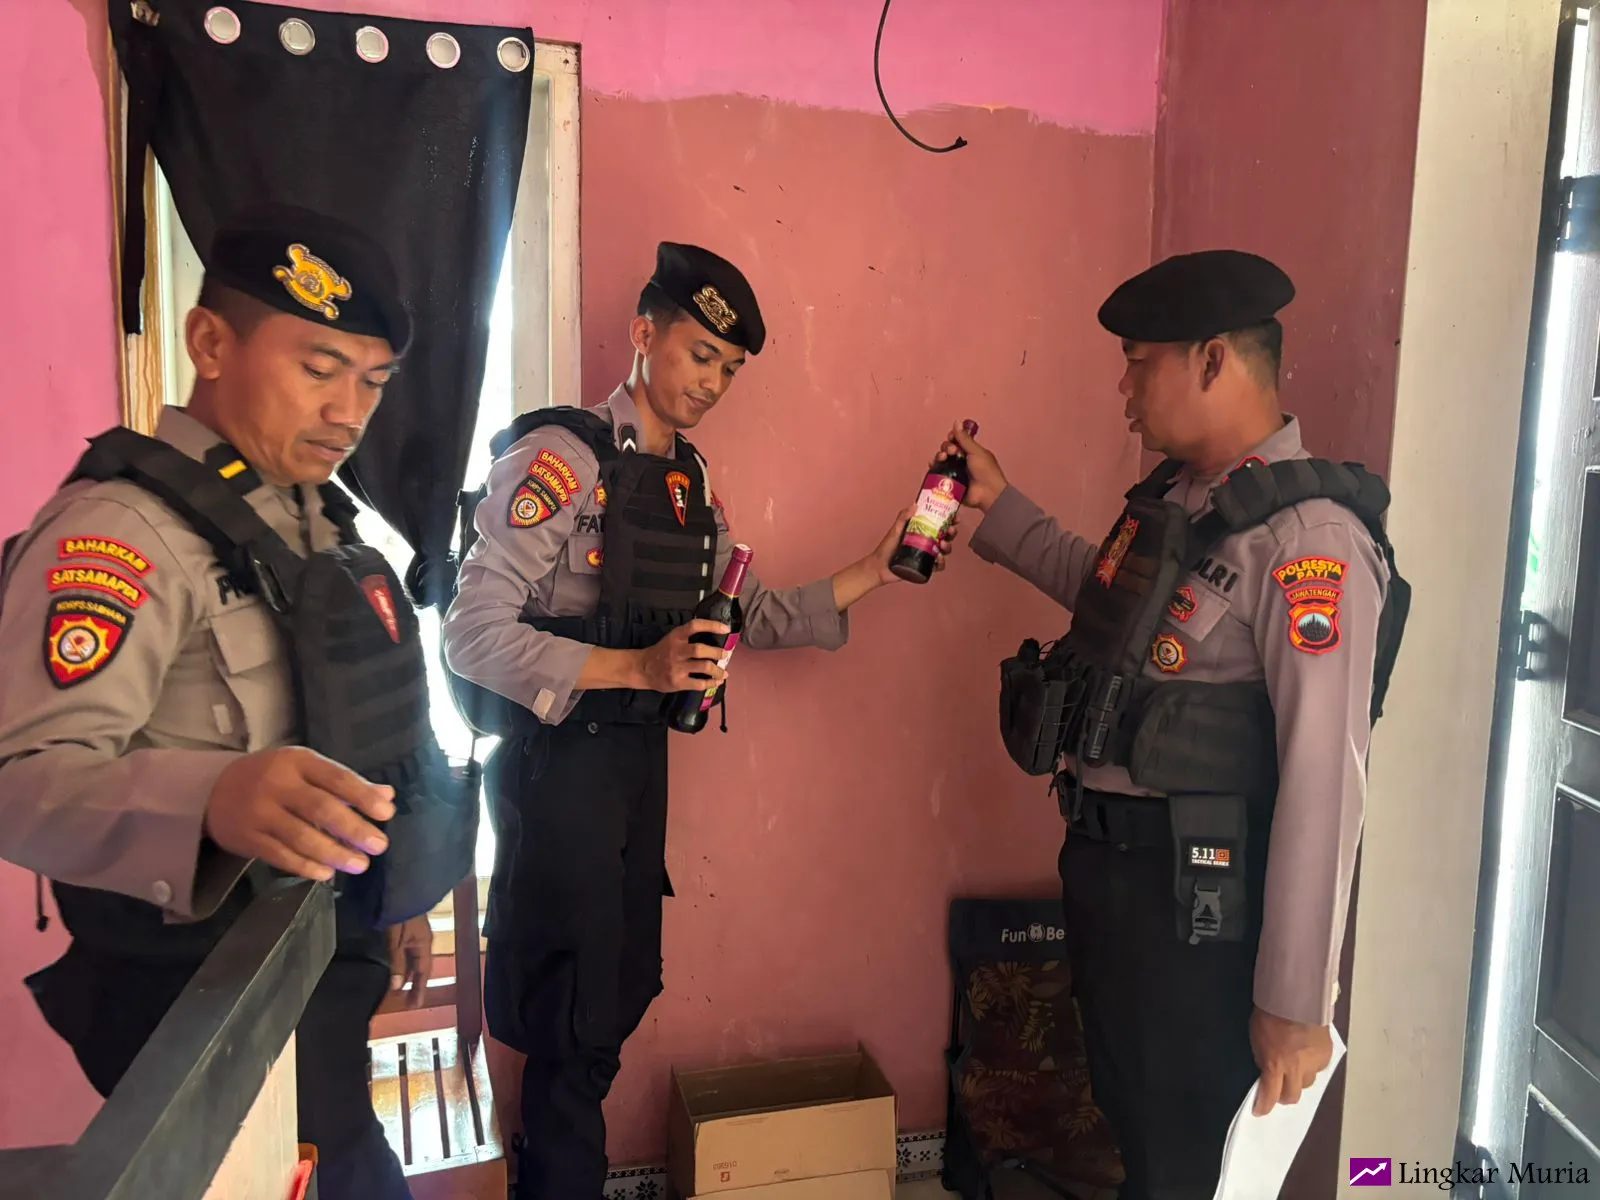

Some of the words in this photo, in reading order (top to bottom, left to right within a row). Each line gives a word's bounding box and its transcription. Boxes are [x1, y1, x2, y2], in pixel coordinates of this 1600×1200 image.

[531, 464, 568, 503] SATSAMAPTA
[541, 451, 578, 490] BAHARKAM
[65, 540, 148, 572] BAHARKAM
[1279, 559, 1342, 581] POLRESTA
[1297, 570, 1328, 581] PATI
[51, 569, 140, 602] SATSAMAPTA
[1191, 847, 1215, 860] 5.11
[1000, 928, 1027, 943] Fun
